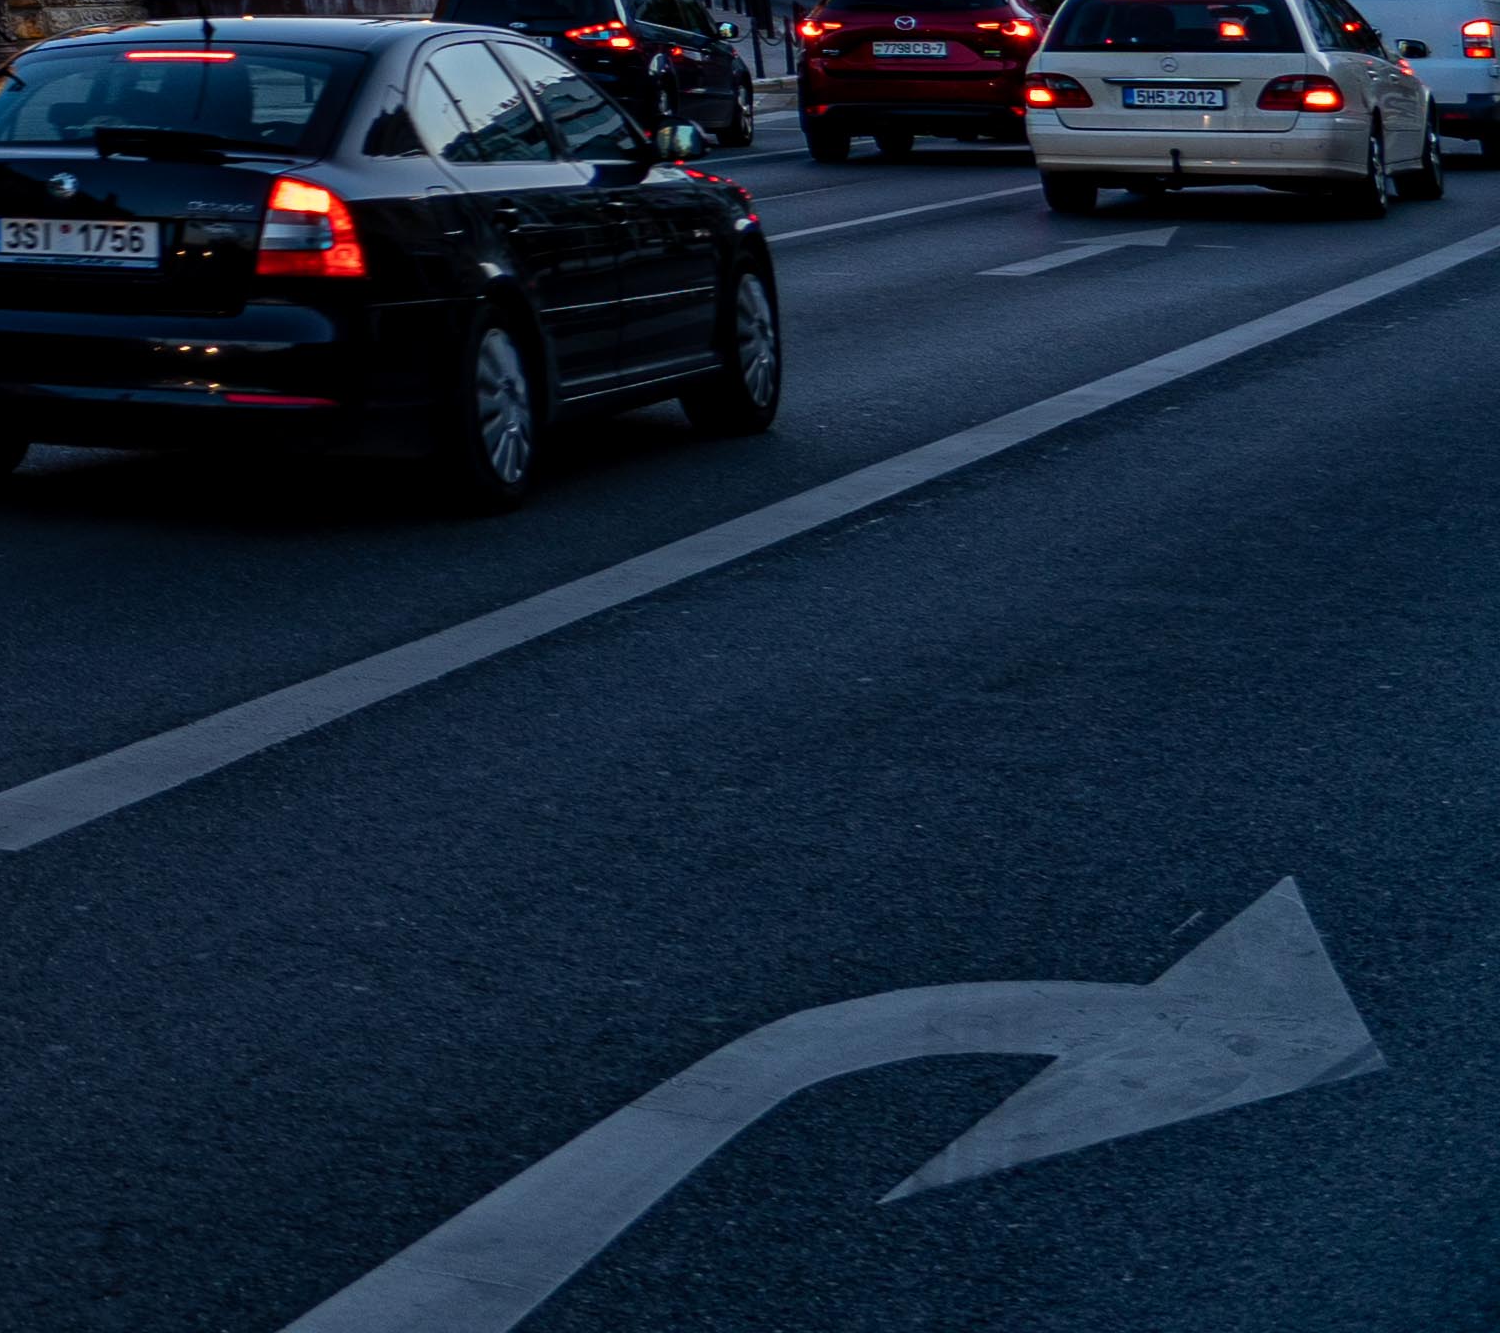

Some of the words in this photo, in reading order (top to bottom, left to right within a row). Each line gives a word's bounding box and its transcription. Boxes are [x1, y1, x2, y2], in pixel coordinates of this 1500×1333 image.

[1137, 90, 1166, 104] 5H5
[1176, 90, 1217, 105] 2012
[79, 224, 145, 254] 1756
